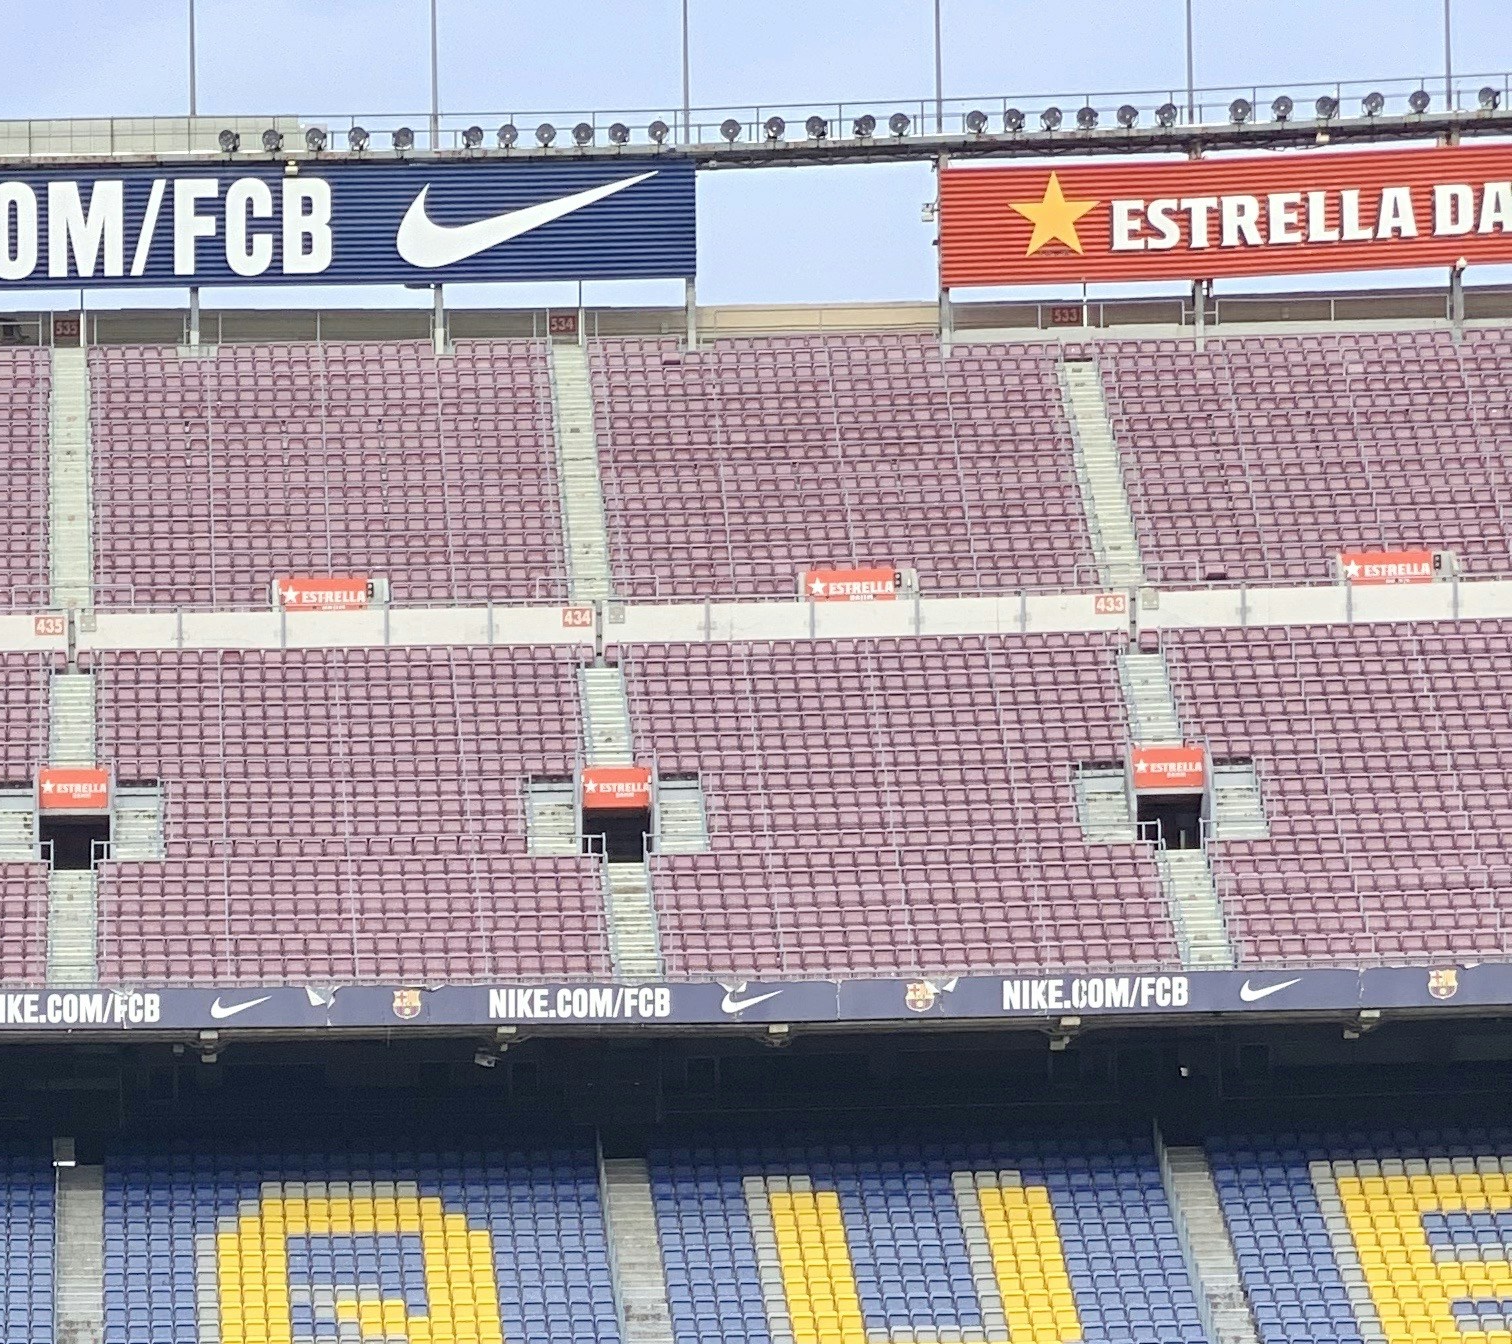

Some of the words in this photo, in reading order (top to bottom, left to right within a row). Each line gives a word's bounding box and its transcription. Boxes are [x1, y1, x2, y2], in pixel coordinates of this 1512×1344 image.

[1110, 186, 1419, 251] ESTRELLA
[1054, 309, 1078, 322] 533
[551, 317, 574, 331] 534
[1364, 562, 1430, 577] ESTRELLA
[829, 580, 894, 594] ESTRELLA
[302, 590, 366, 603] ESTRELLA
[1096, 597, 1124, 612] 433
[564, 610, 591, 625] 434
[38, 618, 63, 633] 435
[1150, 761, 1202, 773] ESTRELLA
[56, 783, 107, 794] ESTRELLA
[599, 782, 650, 793] ESTRELLA
[1002, 977, 1189, 1010] NIKE.COM/FCB
[489, 988, 671, 1018] NIKE.COM/FCB
